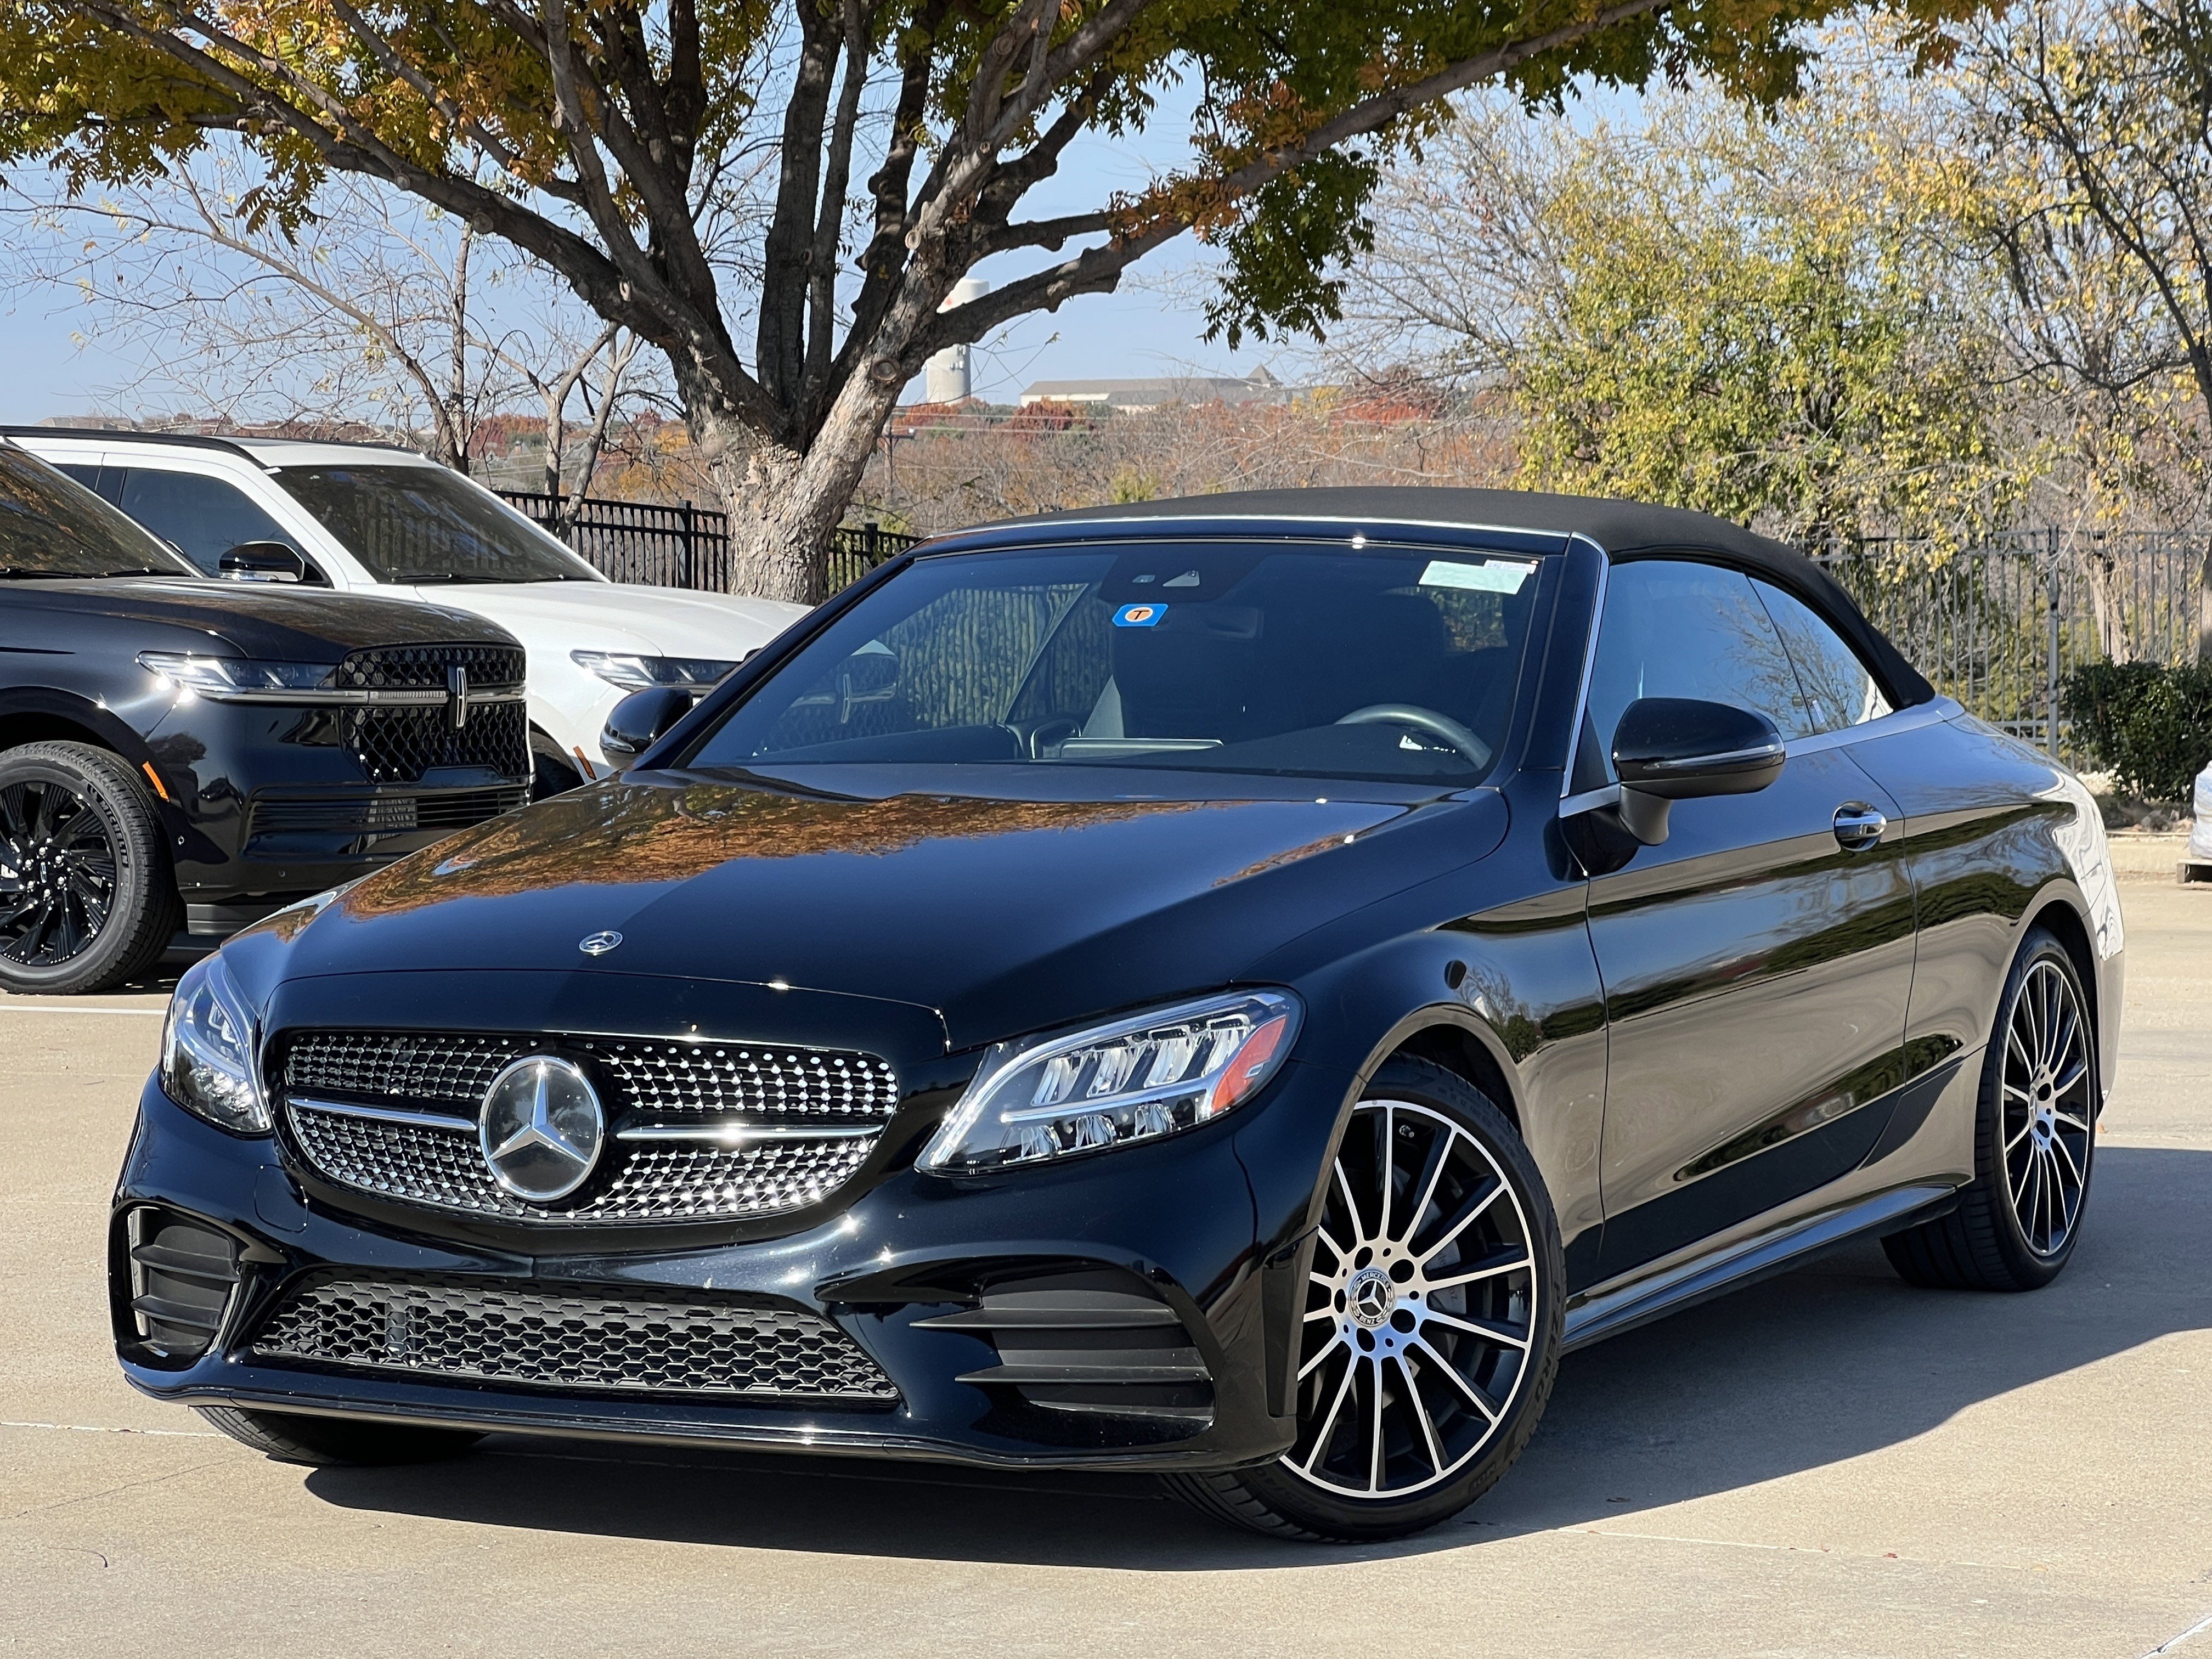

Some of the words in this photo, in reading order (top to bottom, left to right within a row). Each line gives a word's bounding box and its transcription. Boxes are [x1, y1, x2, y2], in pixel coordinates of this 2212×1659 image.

[1133, 610, 1150, 620] T
[100, 800, 129, 867] MICHELIN
[1362, 1272, 1390, 1288] MERCEDES
[1359, 1316, 1375, 1325] BENZ
[1536, 1311, 1560, 1402] ZERO
